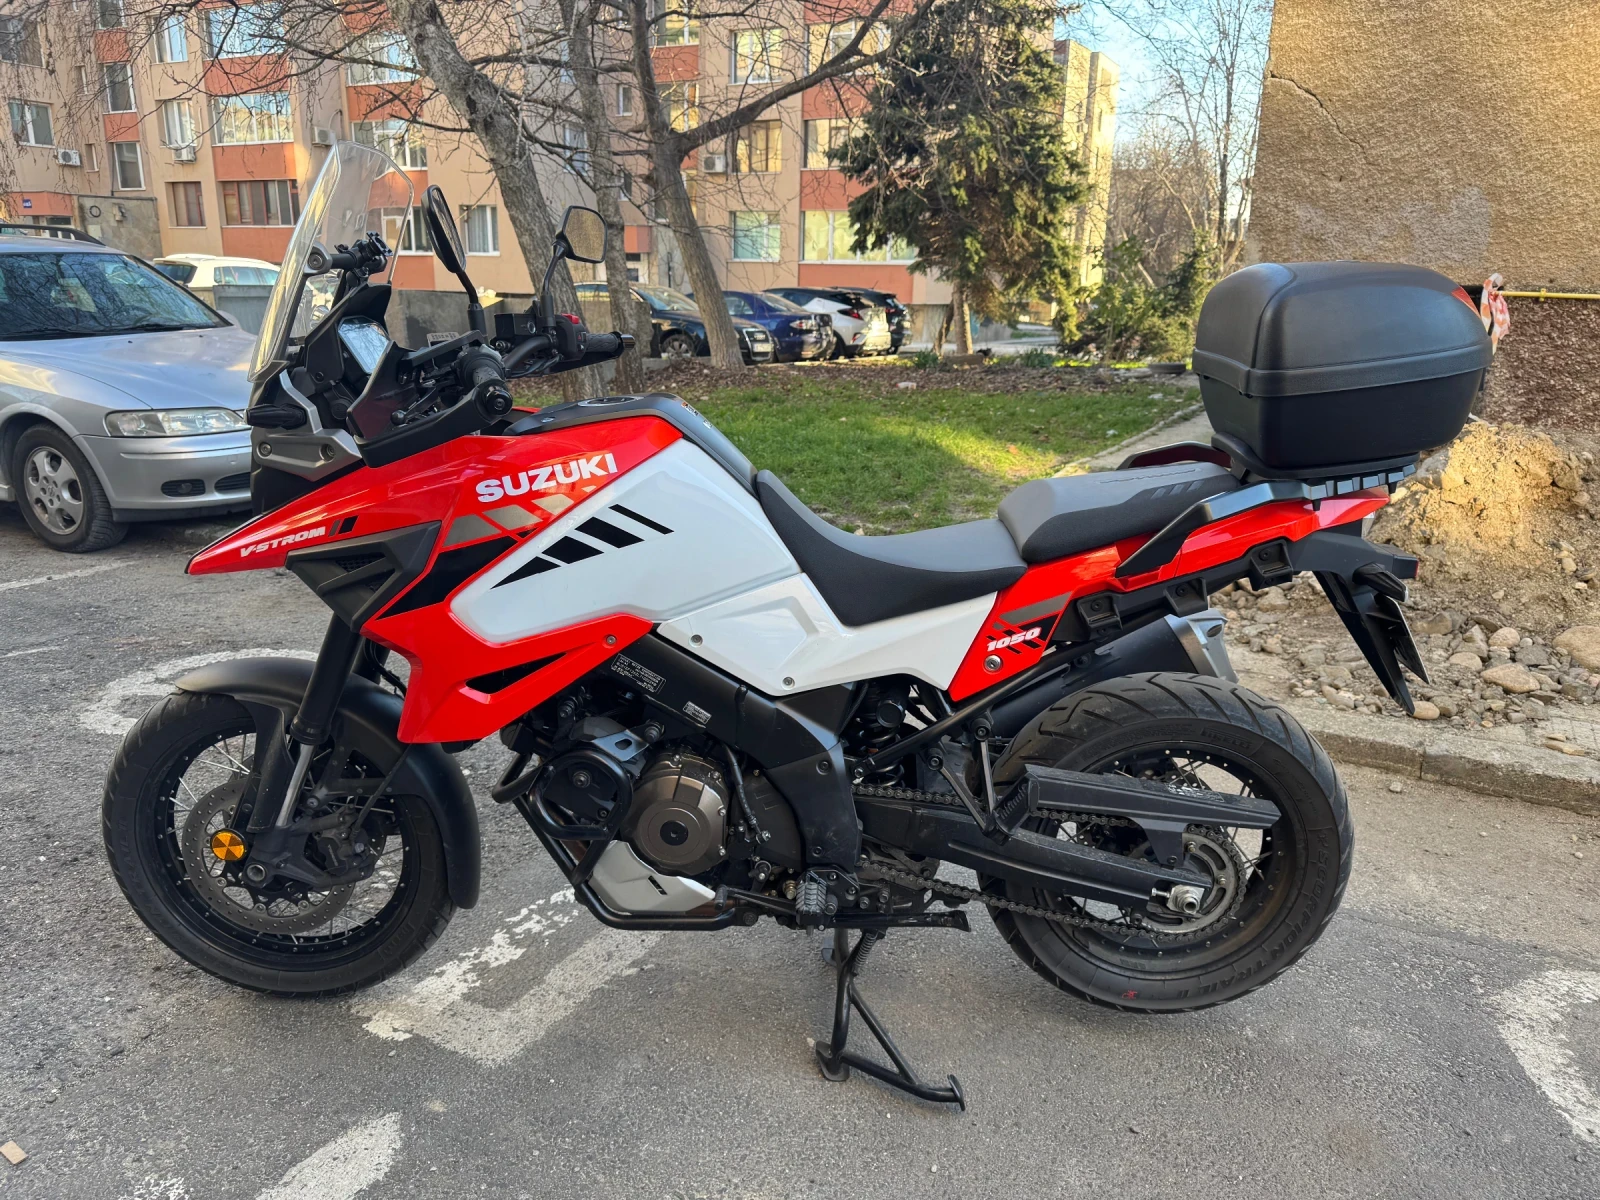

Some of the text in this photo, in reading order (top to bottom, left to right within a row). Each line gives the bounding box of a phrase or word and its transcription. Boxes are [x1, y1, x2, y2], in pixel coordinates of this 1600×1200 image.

[475, 452, 618, 503] SUZUKI
[241, 526, 326, 557] V-STROM
[987, 627, 1042, 652] 1050
[1270, 850, 1330, 958] SCORPION
[1199, 959, 1268, 993] TRAIL
